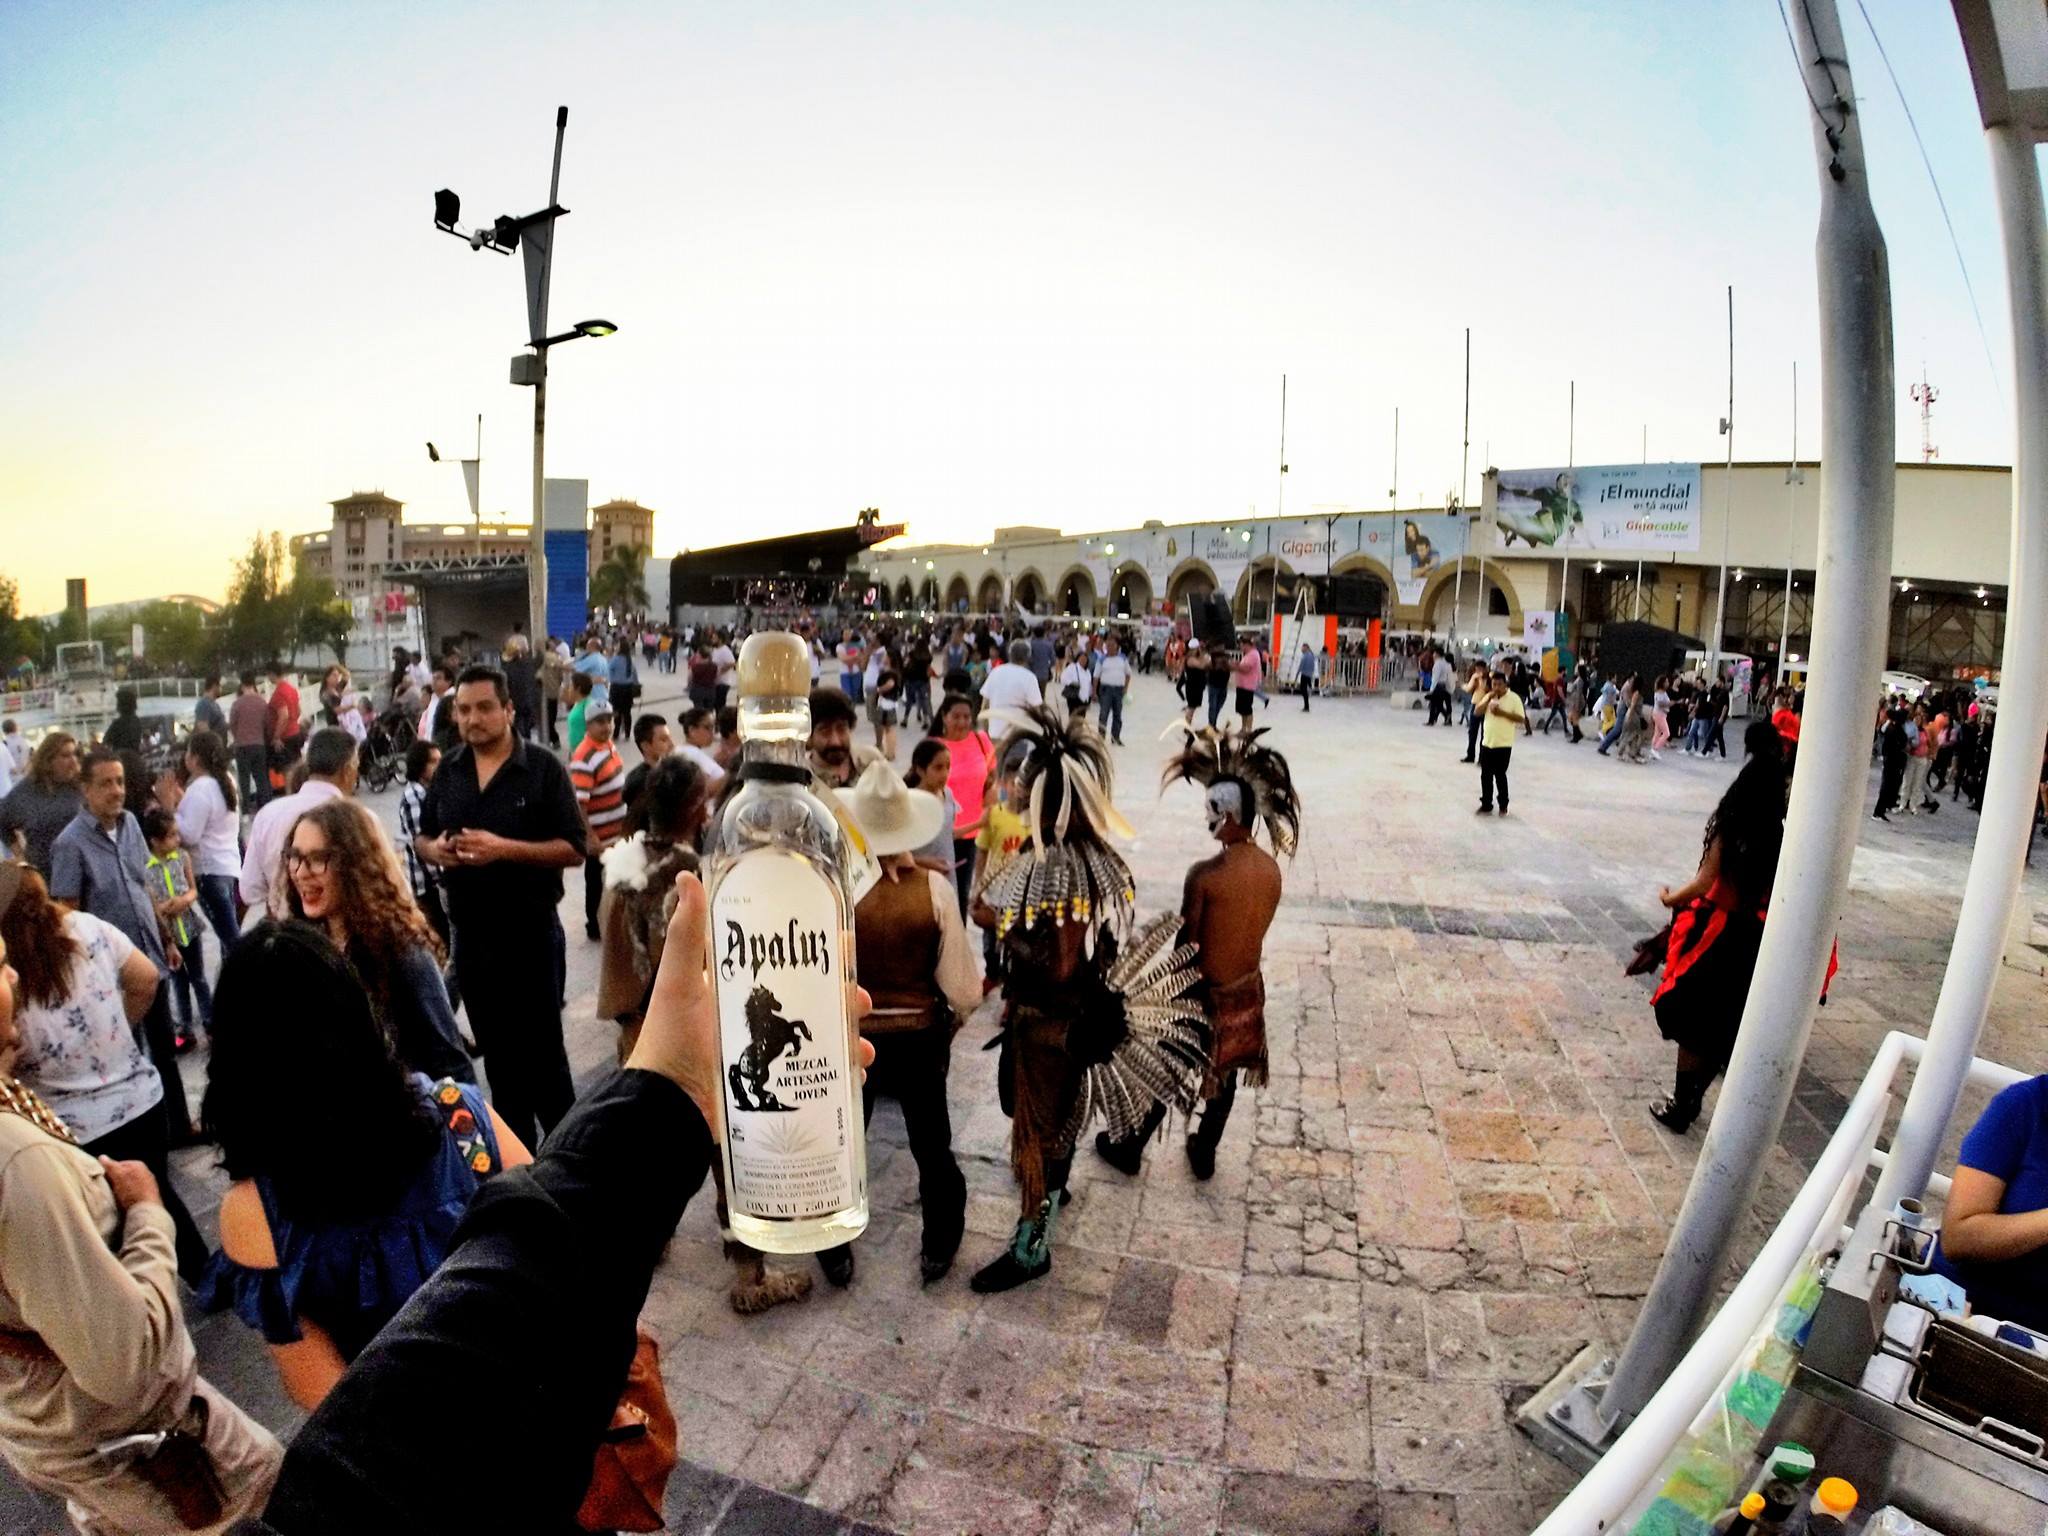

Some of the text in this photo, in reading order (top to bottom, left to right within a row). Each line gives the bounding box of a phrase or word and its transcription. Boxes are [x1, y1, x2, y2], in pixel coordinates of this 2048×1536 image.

[1624, 482, 1690, 499] mundial
[721, 917, 830, 982] Apaluz
[785, 1056, 830, 1071] MEZCAL
[776, 1069, 840, 1088] ARTESANAL
[793, 1086, 828, 1102] JOVEN
